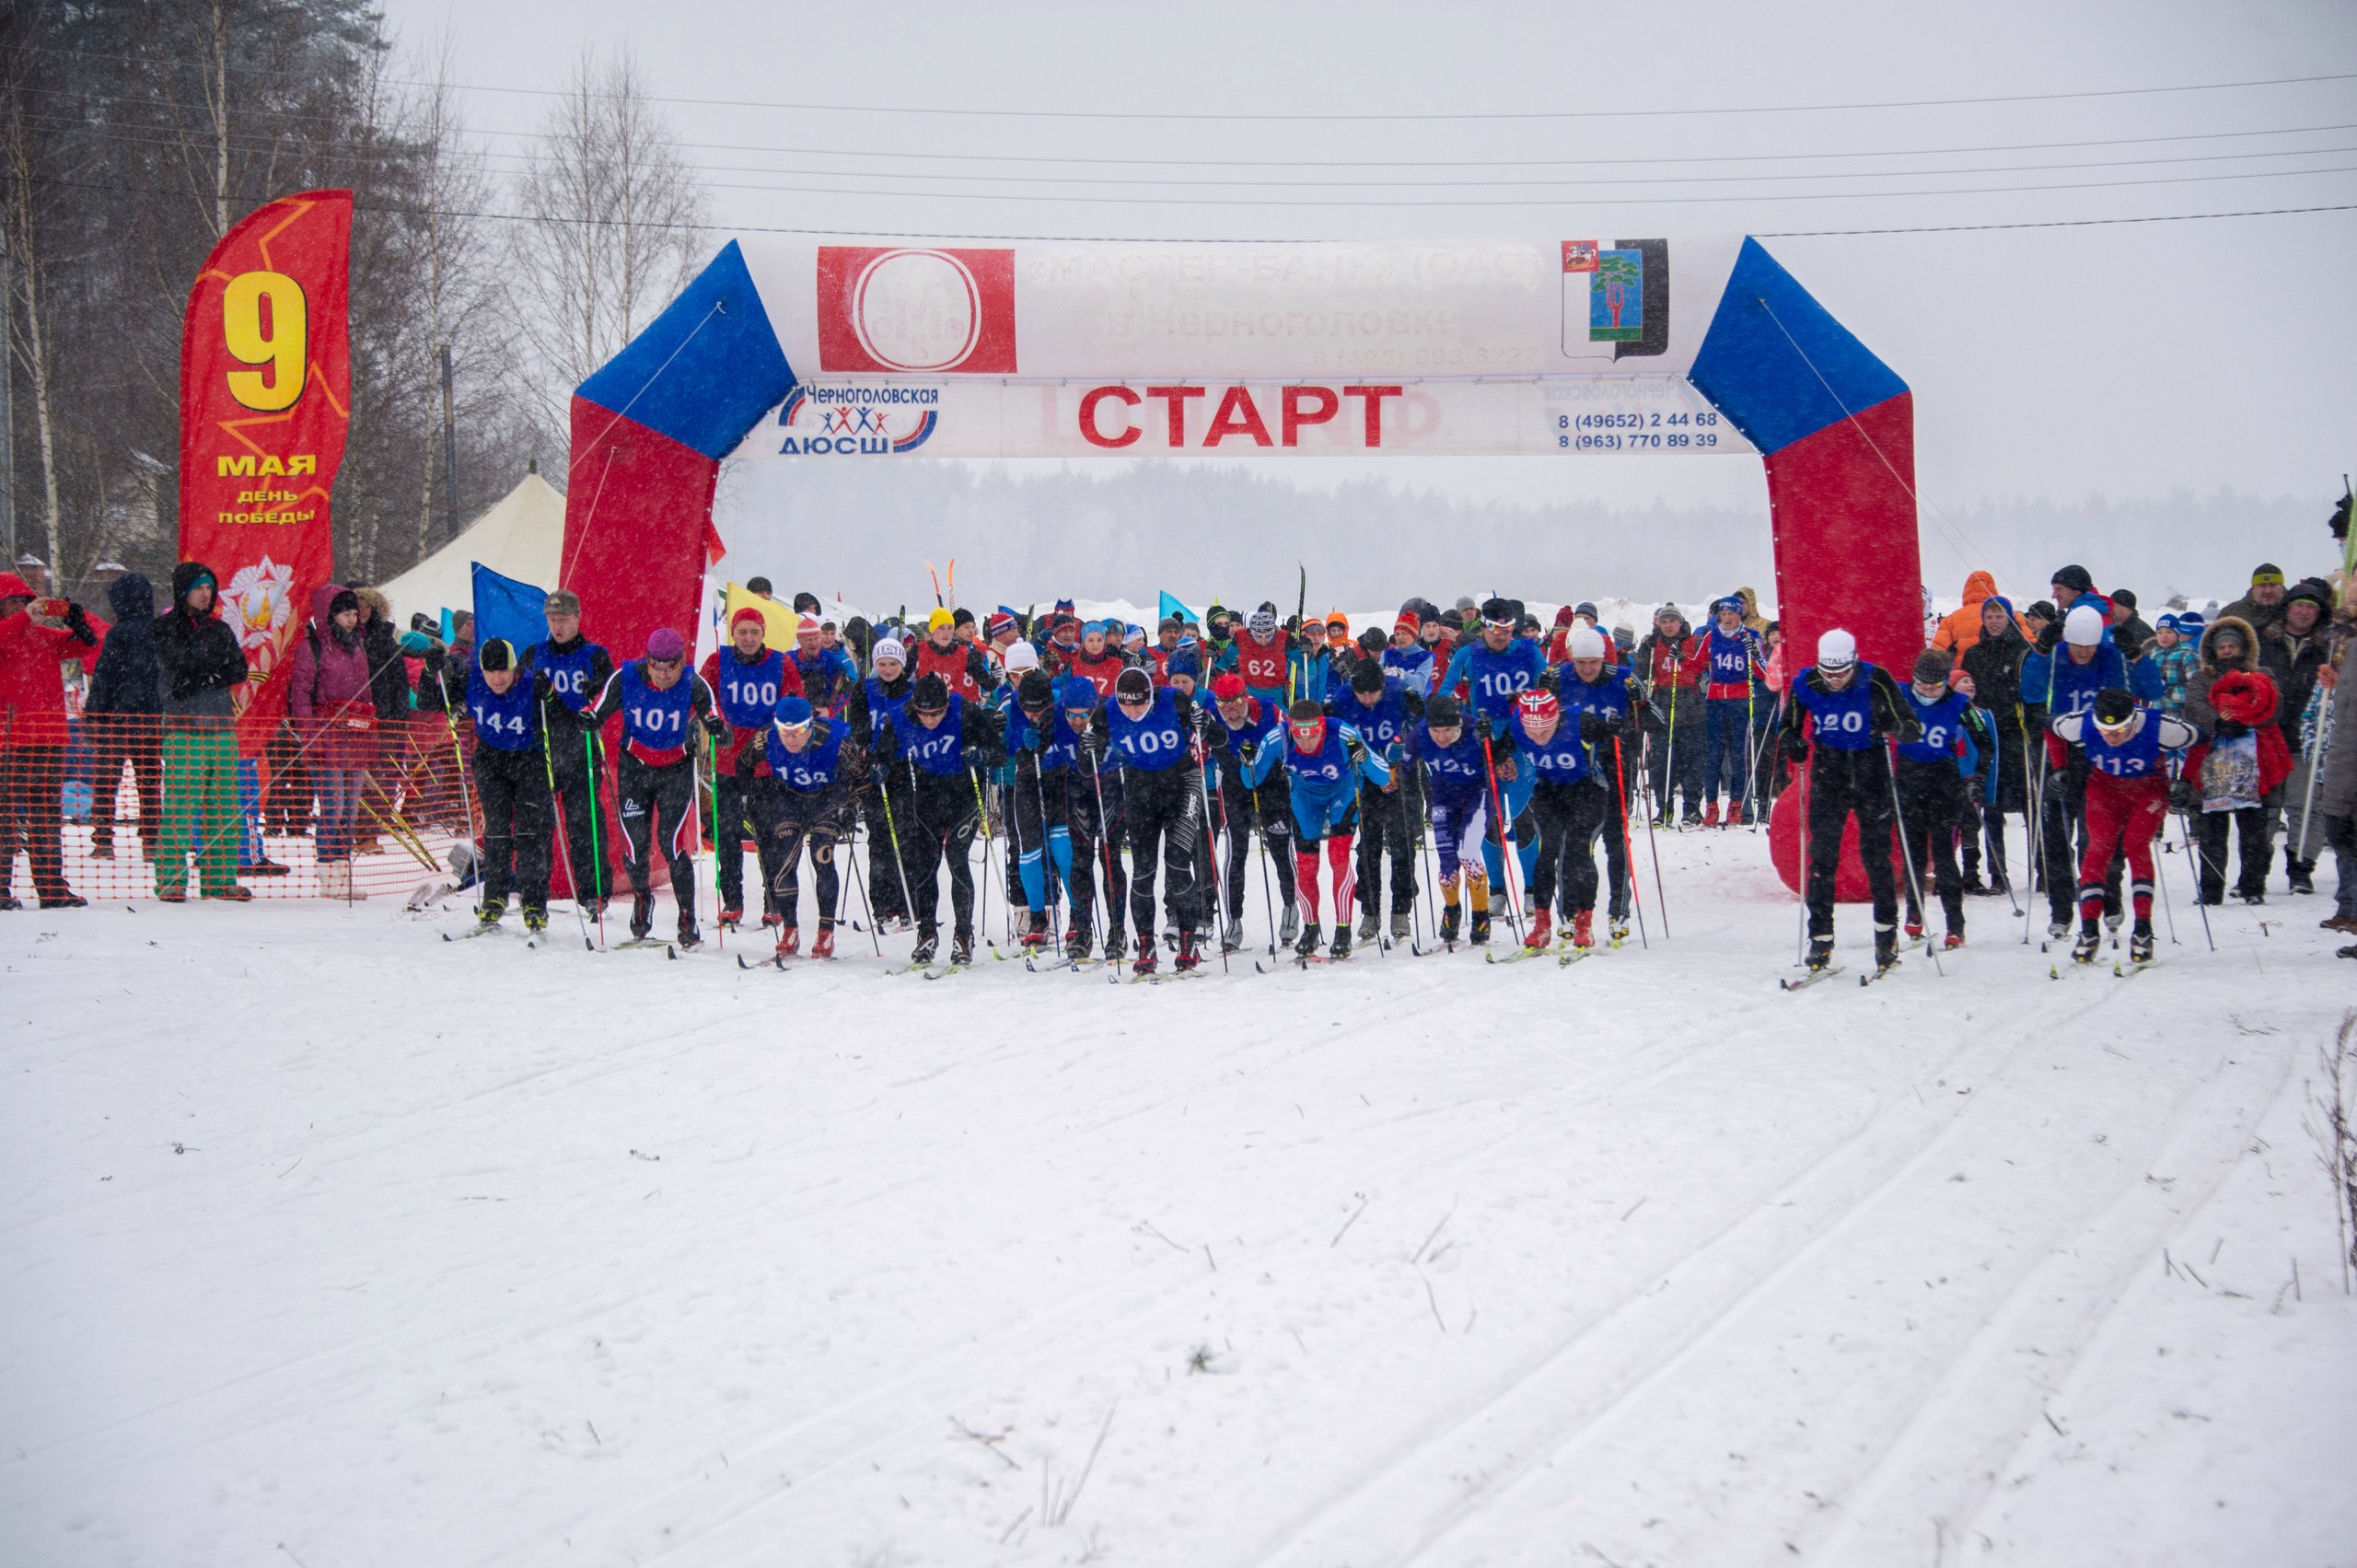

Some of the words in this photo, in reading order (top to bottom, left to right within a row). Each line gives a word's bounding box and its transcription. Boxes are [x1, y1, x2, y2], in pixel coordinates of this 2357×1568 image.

[224, 271, 308, 412] 9
[806, 384, 939, 406] Черноголовская
[1079, 385, 1403, 449] СТАРТ
[1558, 415, 1570, 429] 8
[1575, 414, 1644, 432] (49652)
[1650, 414, 1662, 427] 2
[1666, 414, 1689, 427] 44
[1695, 413, 1718, 427] 68
[779, 436, 888, 455] ДЮСШ
[1558, 436, 1570, 449] 8
[1575, 436, 1622, 451] (963)
[1628, 436, 1662, 449] 770
[1666, 435, 1690, 449] 89
[1695, 435, 1718, 448] 39
[216, 453, 317, 478] МАЯ
[237, 490, 300, 505] ДЕНЬ
[217, 508, 316, 526] ПОБЕДЫ
[1248, 659, 1276, 678] 62
[1714, 653, 1746, 672] 146
[544, 666, 586, 695] 08
[1086, 676, 1109, 694] 7
[1479, 670, 1530, 697] 102
[726, 682, 777, 706] 100
[2068, 686, 2106, 713] 12
[471, 704, 526, 735] 144
[631, 707, 681, 732] 101
[1063, 743, 1113, 762] 17
[1119, 730, 1179, 754] 109
[1525, 751, 1576, 771] 149
